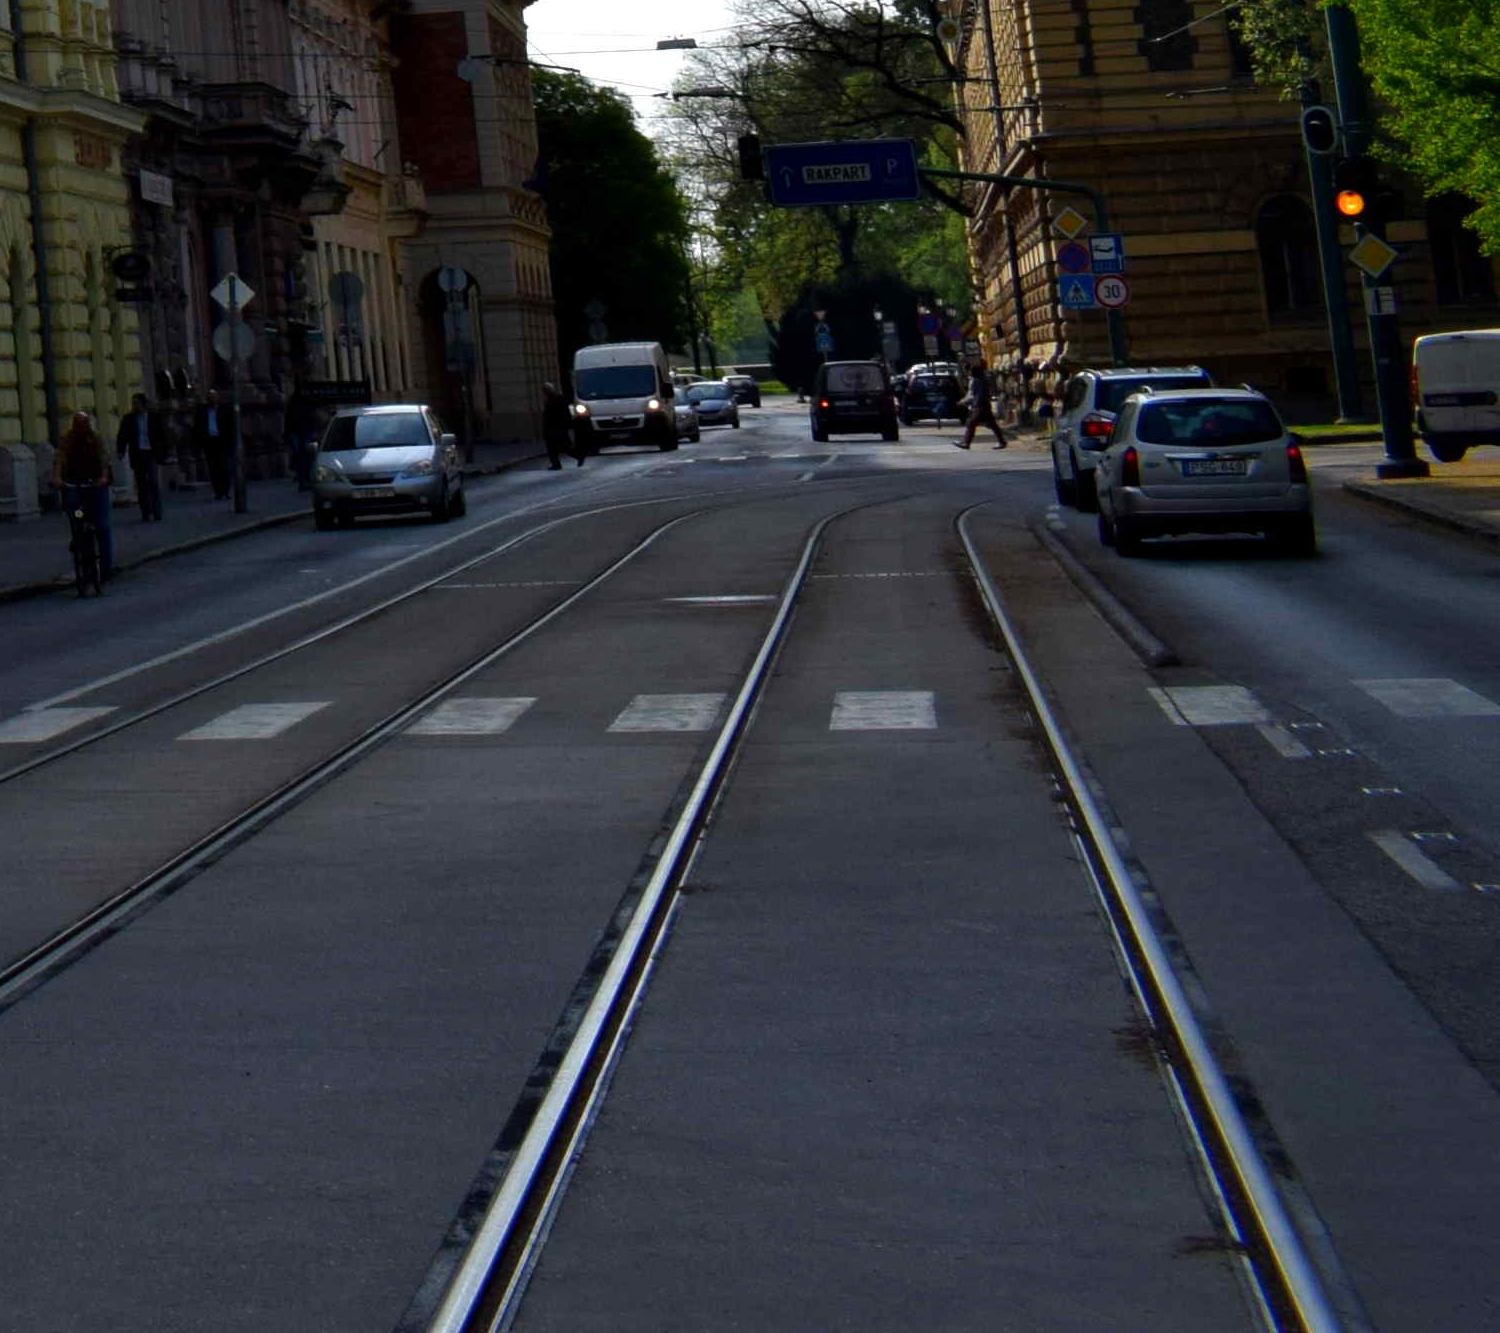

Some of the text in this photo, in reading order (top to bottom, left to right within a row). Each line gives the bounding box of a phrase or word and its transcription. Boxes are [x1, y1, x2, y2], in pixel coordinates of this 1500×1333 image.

[805, 166, 867, 181] RAKPART
[886, 157, 899, 174] P
[1103, 284, 1122, 300] 30
